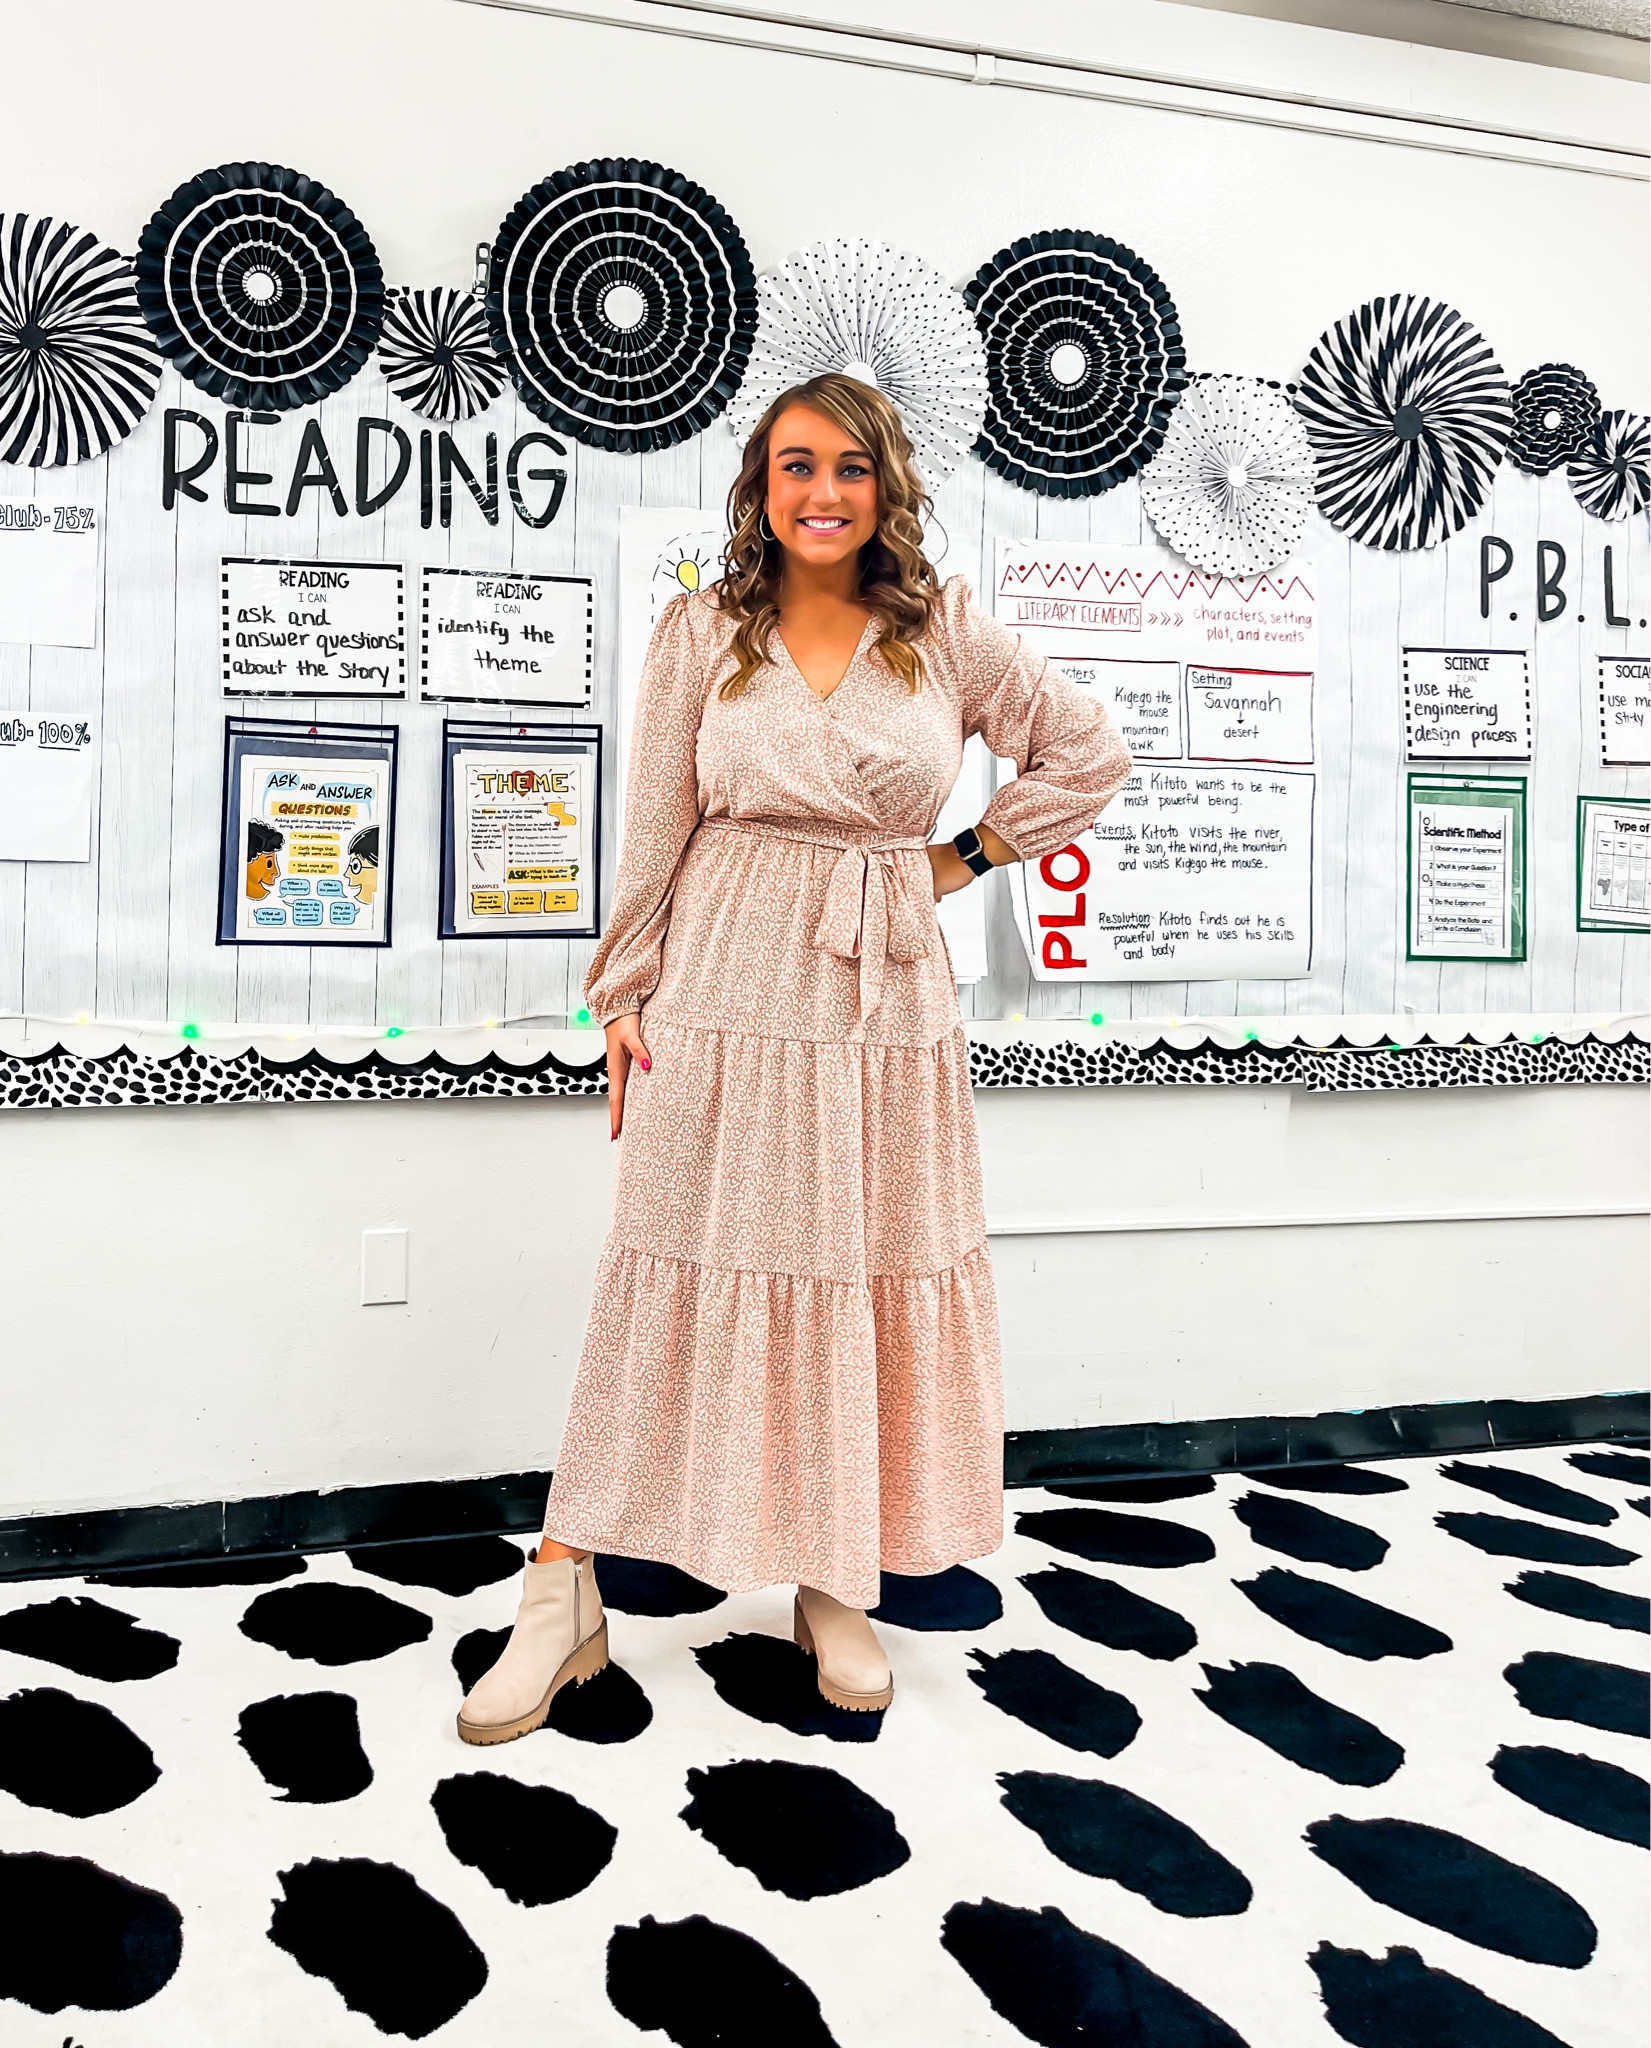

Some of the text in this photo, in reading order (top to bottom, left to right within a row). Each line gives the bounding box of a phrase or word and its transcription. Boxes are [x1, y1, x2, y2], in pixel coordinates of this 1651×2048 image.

[162, 408, 568, 529] READING
[54, 506, 96, 530] 75%
[279, 570, 350, 588] READING
[298, 593, 327, 603] I CAN
[476, 581, 543, 600] READING
[237, 605, 332, 626] ask and
[494, 603, 520, 614] I CAN
[1018, 602, 1140, 626] LITERARY ELEMENTS
[1194, 604, 1312, 628] characters, setting
[438, 618, 555, 645] identify the
[1207, 627, 1304, 643] plot, and events
[235, 632, 400, 658] answer questions
[232, 659, 287, 675] about
[296, 660, 328, 677] the
[474, 649, 542, 673] theme
[1444, 657, 1490, 671] SCIENCE
[1191, 671, 1232, 687] Setting
[1615, 665, 1651, 679] SOCIA
[1155, 690, 1172, 704] the
[1414, 683, 1474, 699] use the
[1204, 690, 1282, 714] Savannah
[1139, 707, 1169, 718] mouse
[1414, 702, 1498, 726] engineering
[38, 721, 90, 746] 100%
[1122, 725, 1169, 736] mountain
[1223, 725, 1260, 739] desert
[1414, 725, 1517, 748] design process
[268, 774, 316, 791] ASK AND
[477, 773, 569, 793] THEME
[1150, 773, 1187, 791] Kitoto
[1196, 779, 1225, 790] wants
[1231, 780, 1244, 792] to
[1250, 781, 1263, 792] be
[1270, 783, 1287, 795] the
[316, 786, 372, 800] ANSWER
[278, 803, 352, 816] QUESTIONS
[1124, 795, 1149, 807] most
[1158, 793, 1198, 812] powerful
[1142, 823, 1178, 840] Kitoto
[1189, 825, 1223, 838] visits
[1228, 826, 1248, 840] the
[1254, 828, 1283, 841] river,
[1423, 826, 1502, 840] Scientific Method
[1614, 820, 1650, 833] Type of
[1124, 842, 1287, 858] the sun, the wind, the mountain
[1118, 859, 1136, 871] and
[1143, 858, 1169, 870] visits
[1212, 858, 1226, 870] the
[1231, 859, 1268, 870] mouse.
[1038, 825, 1090, 969] PLO
[1159, 911, 1192, 927] Kitoto
[1200, 911, 1228, 926] finds
[1234, 915, 1251, 926] out
[1257, 915, 1270, 926] he
[1276, 916, 1286, 927] is
[1113, 931, 1155, 950] powerful
[1162, 930, 1189, 940] when
[1197, 929, 1210, 940] he
[1216, 930, 1238, 940] uses
[1245, 929, 1262, 940] his
[1123, 943, 1176, 960] and body
